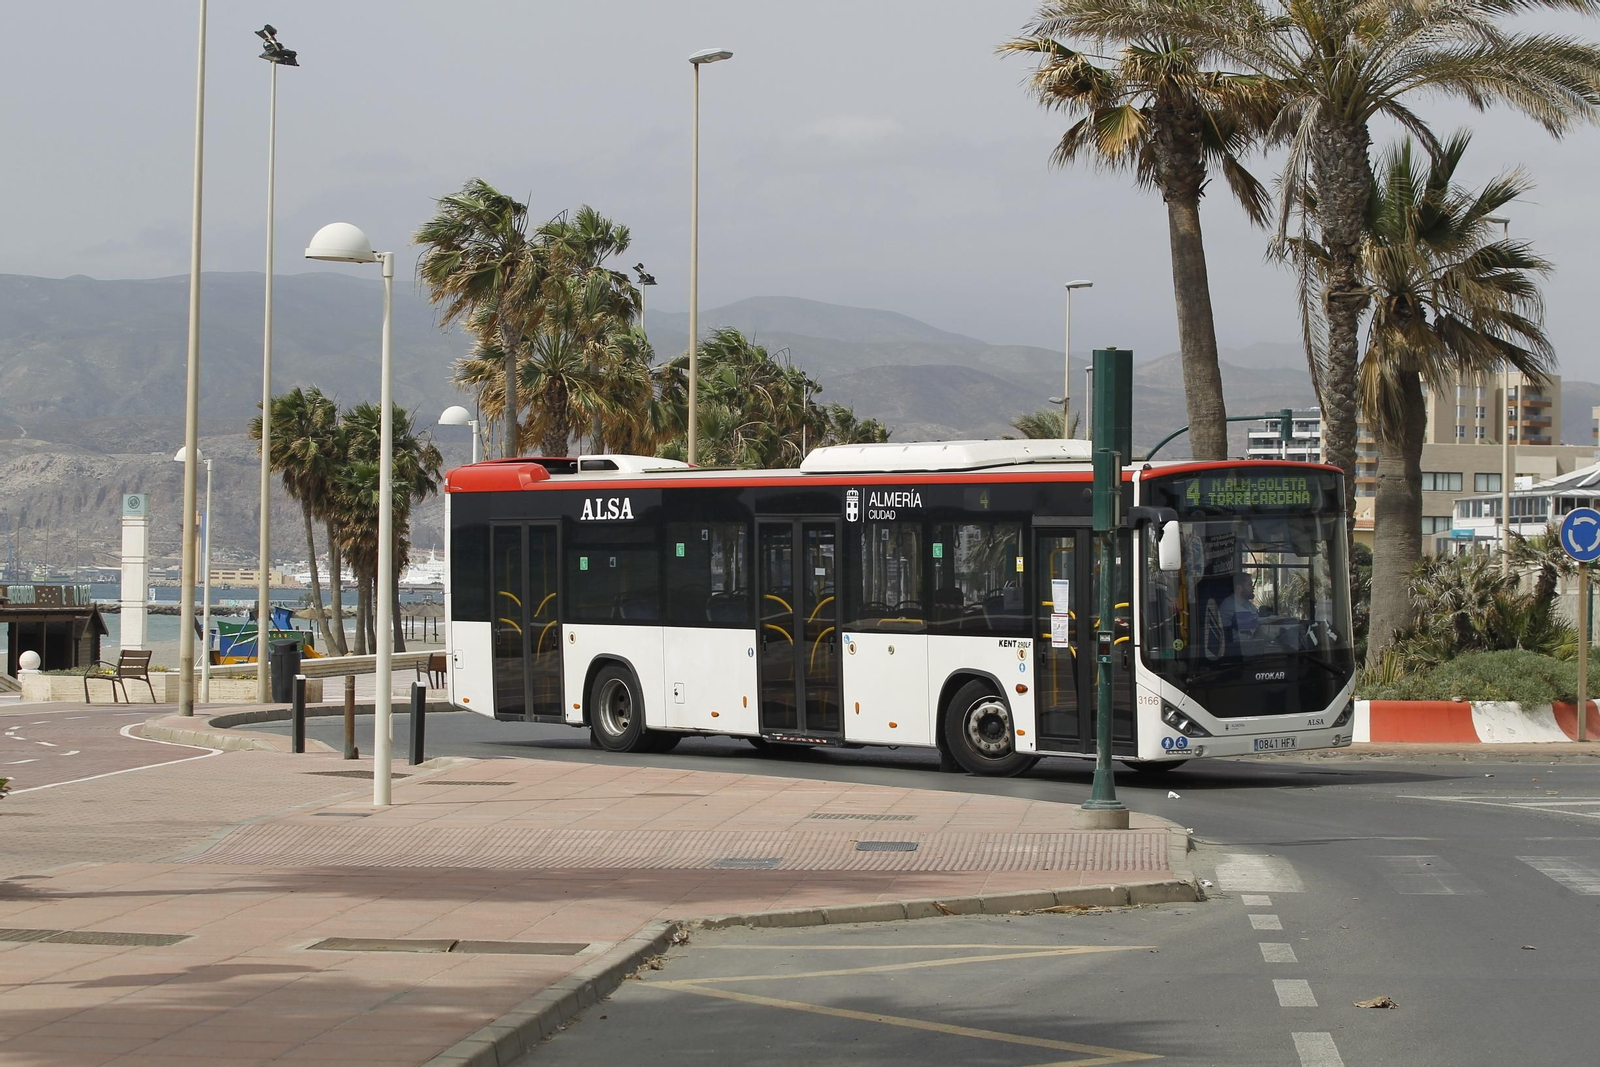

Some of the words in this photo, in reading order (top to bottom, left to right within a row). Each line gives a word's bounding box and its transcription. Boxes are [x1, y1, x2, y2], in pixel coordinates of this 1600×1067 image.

[868, 488, 922, 508] ALMERÍA
[1186, 480, 1200, 505] 4
[1209, 491, 1310, 505] TORRECARDENA
[980, 490, 989, 509] 4
[580, 497, 634, 520] ALSA
[868, 509, 896, 520] CIUDAD
[998, 639, 1017, 647] KENT
[1255, 671, 1285, 680] OTOKAR
[1138, 695, 1159, 706] 3166
[1259, 738, 1278, 749] 0841
[1281, 737, 1296, 748] HFX
